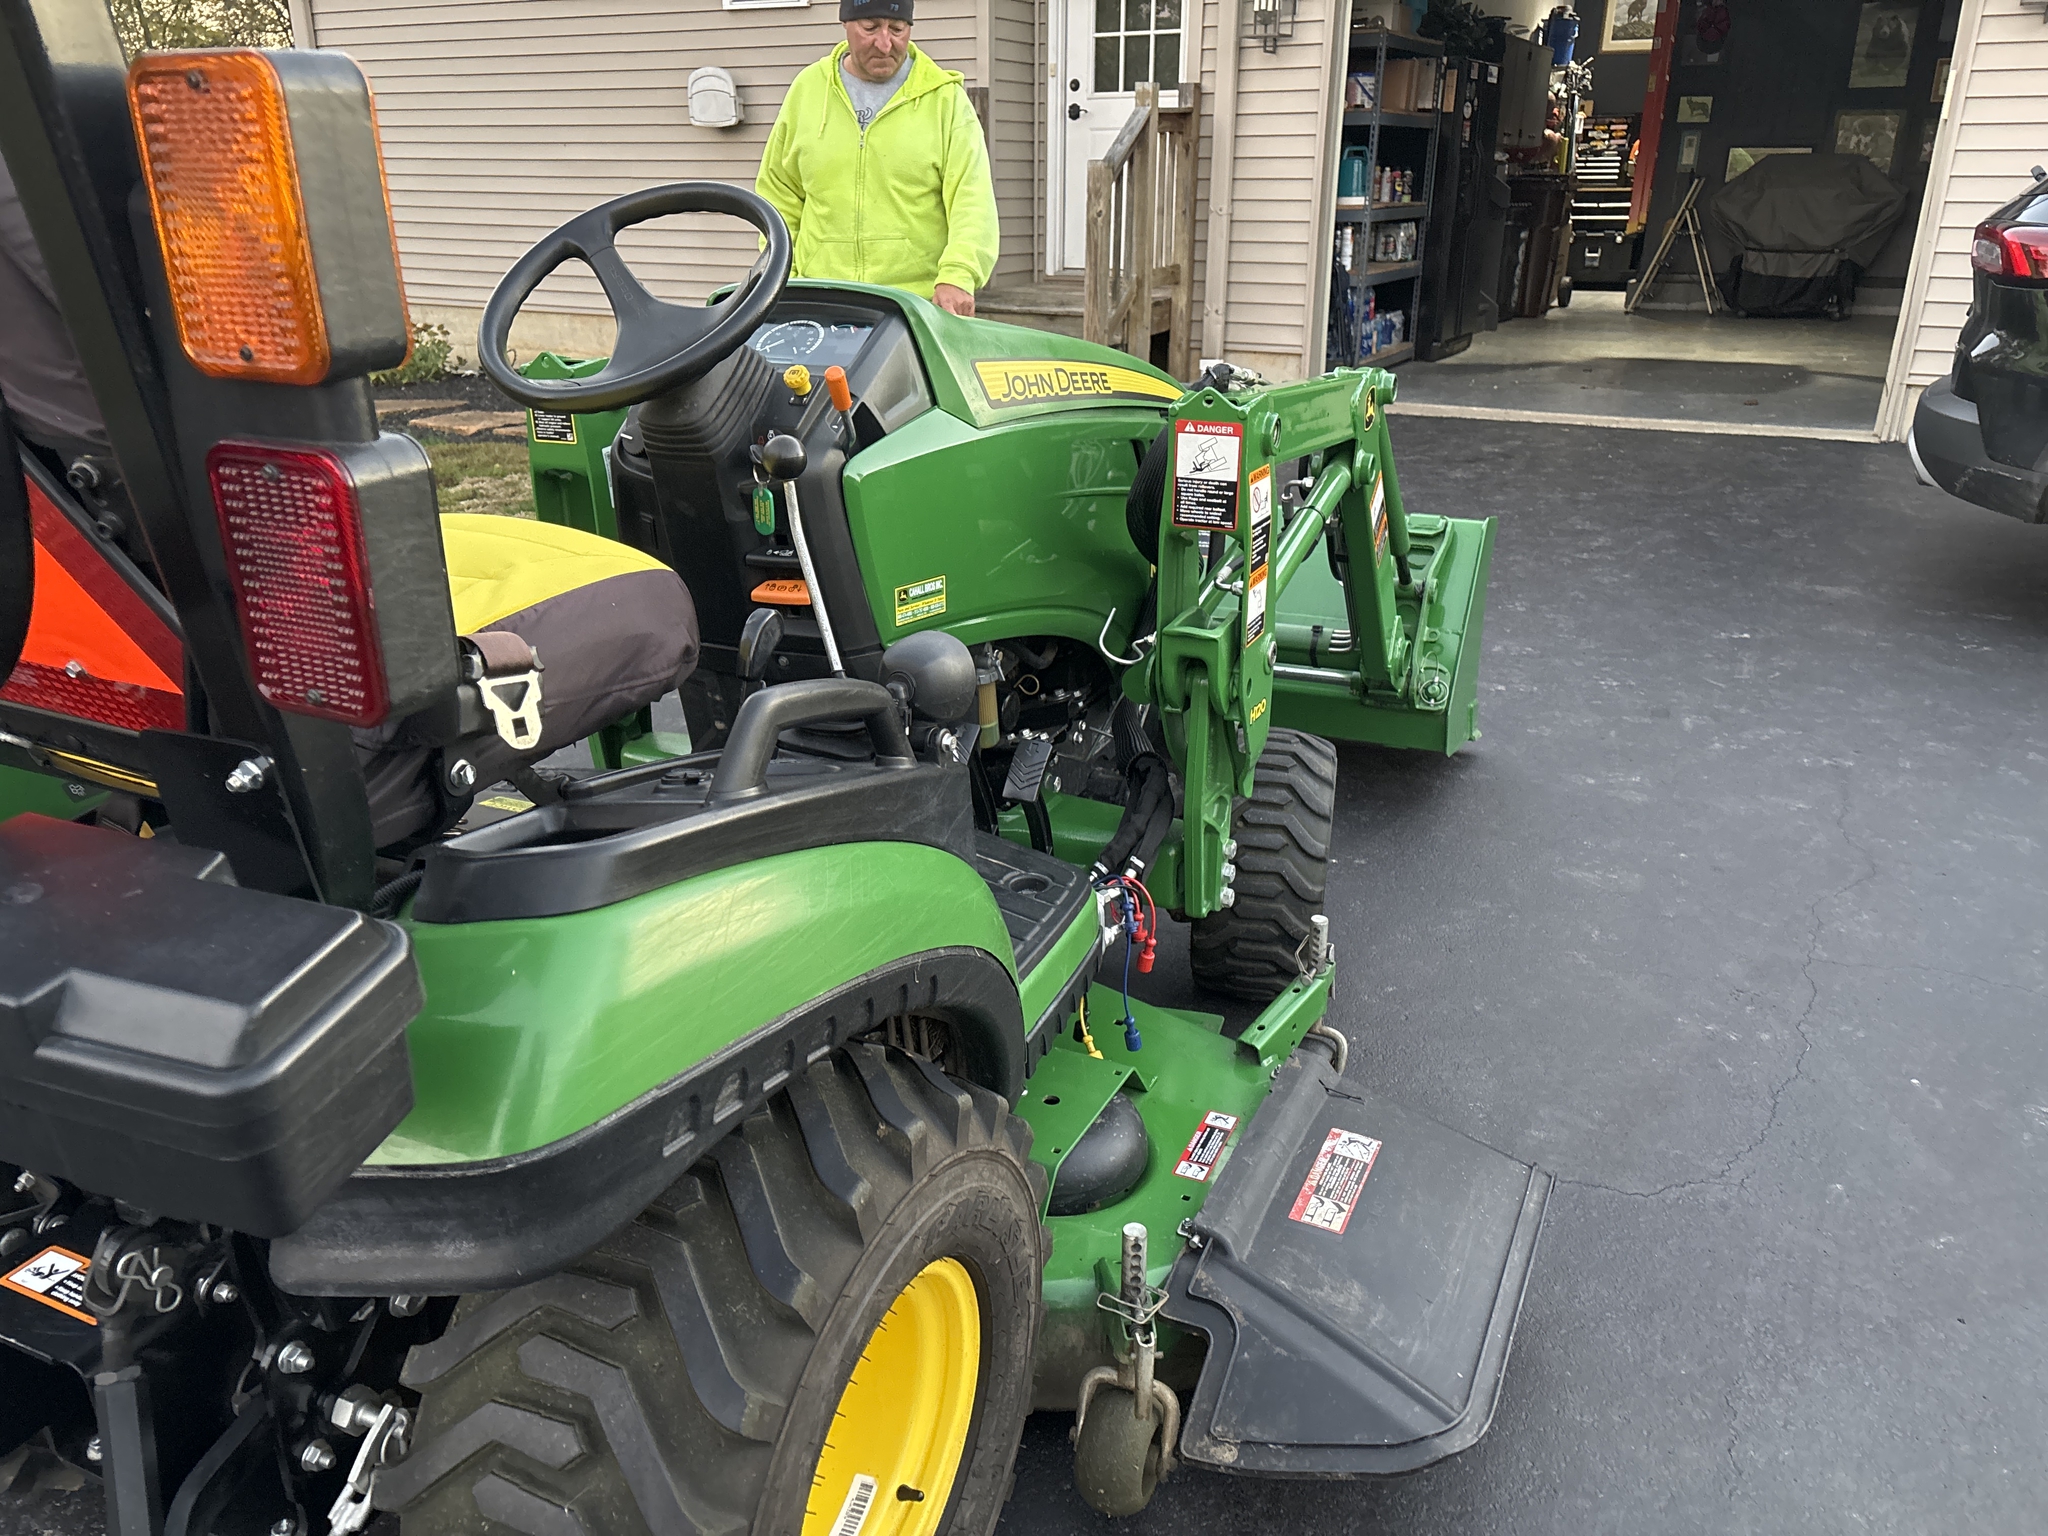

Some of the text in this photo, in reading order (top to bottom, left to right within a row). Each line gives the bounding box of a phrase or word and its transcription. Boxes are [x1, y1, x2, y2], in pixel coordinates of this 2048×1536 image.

[1001, 367, 1112, 398] JOHN DEERE
[1197, 424, 1234, 435] DANGER
[909, 585, 924, 597] CAHALL
[924, 582, 935, 593] BROS
[1249, 698, 1267, 725] H120
[1188, 1130, 1203, 1148] DANGER
[1310, 1158, 1327, 1182] DANGER
